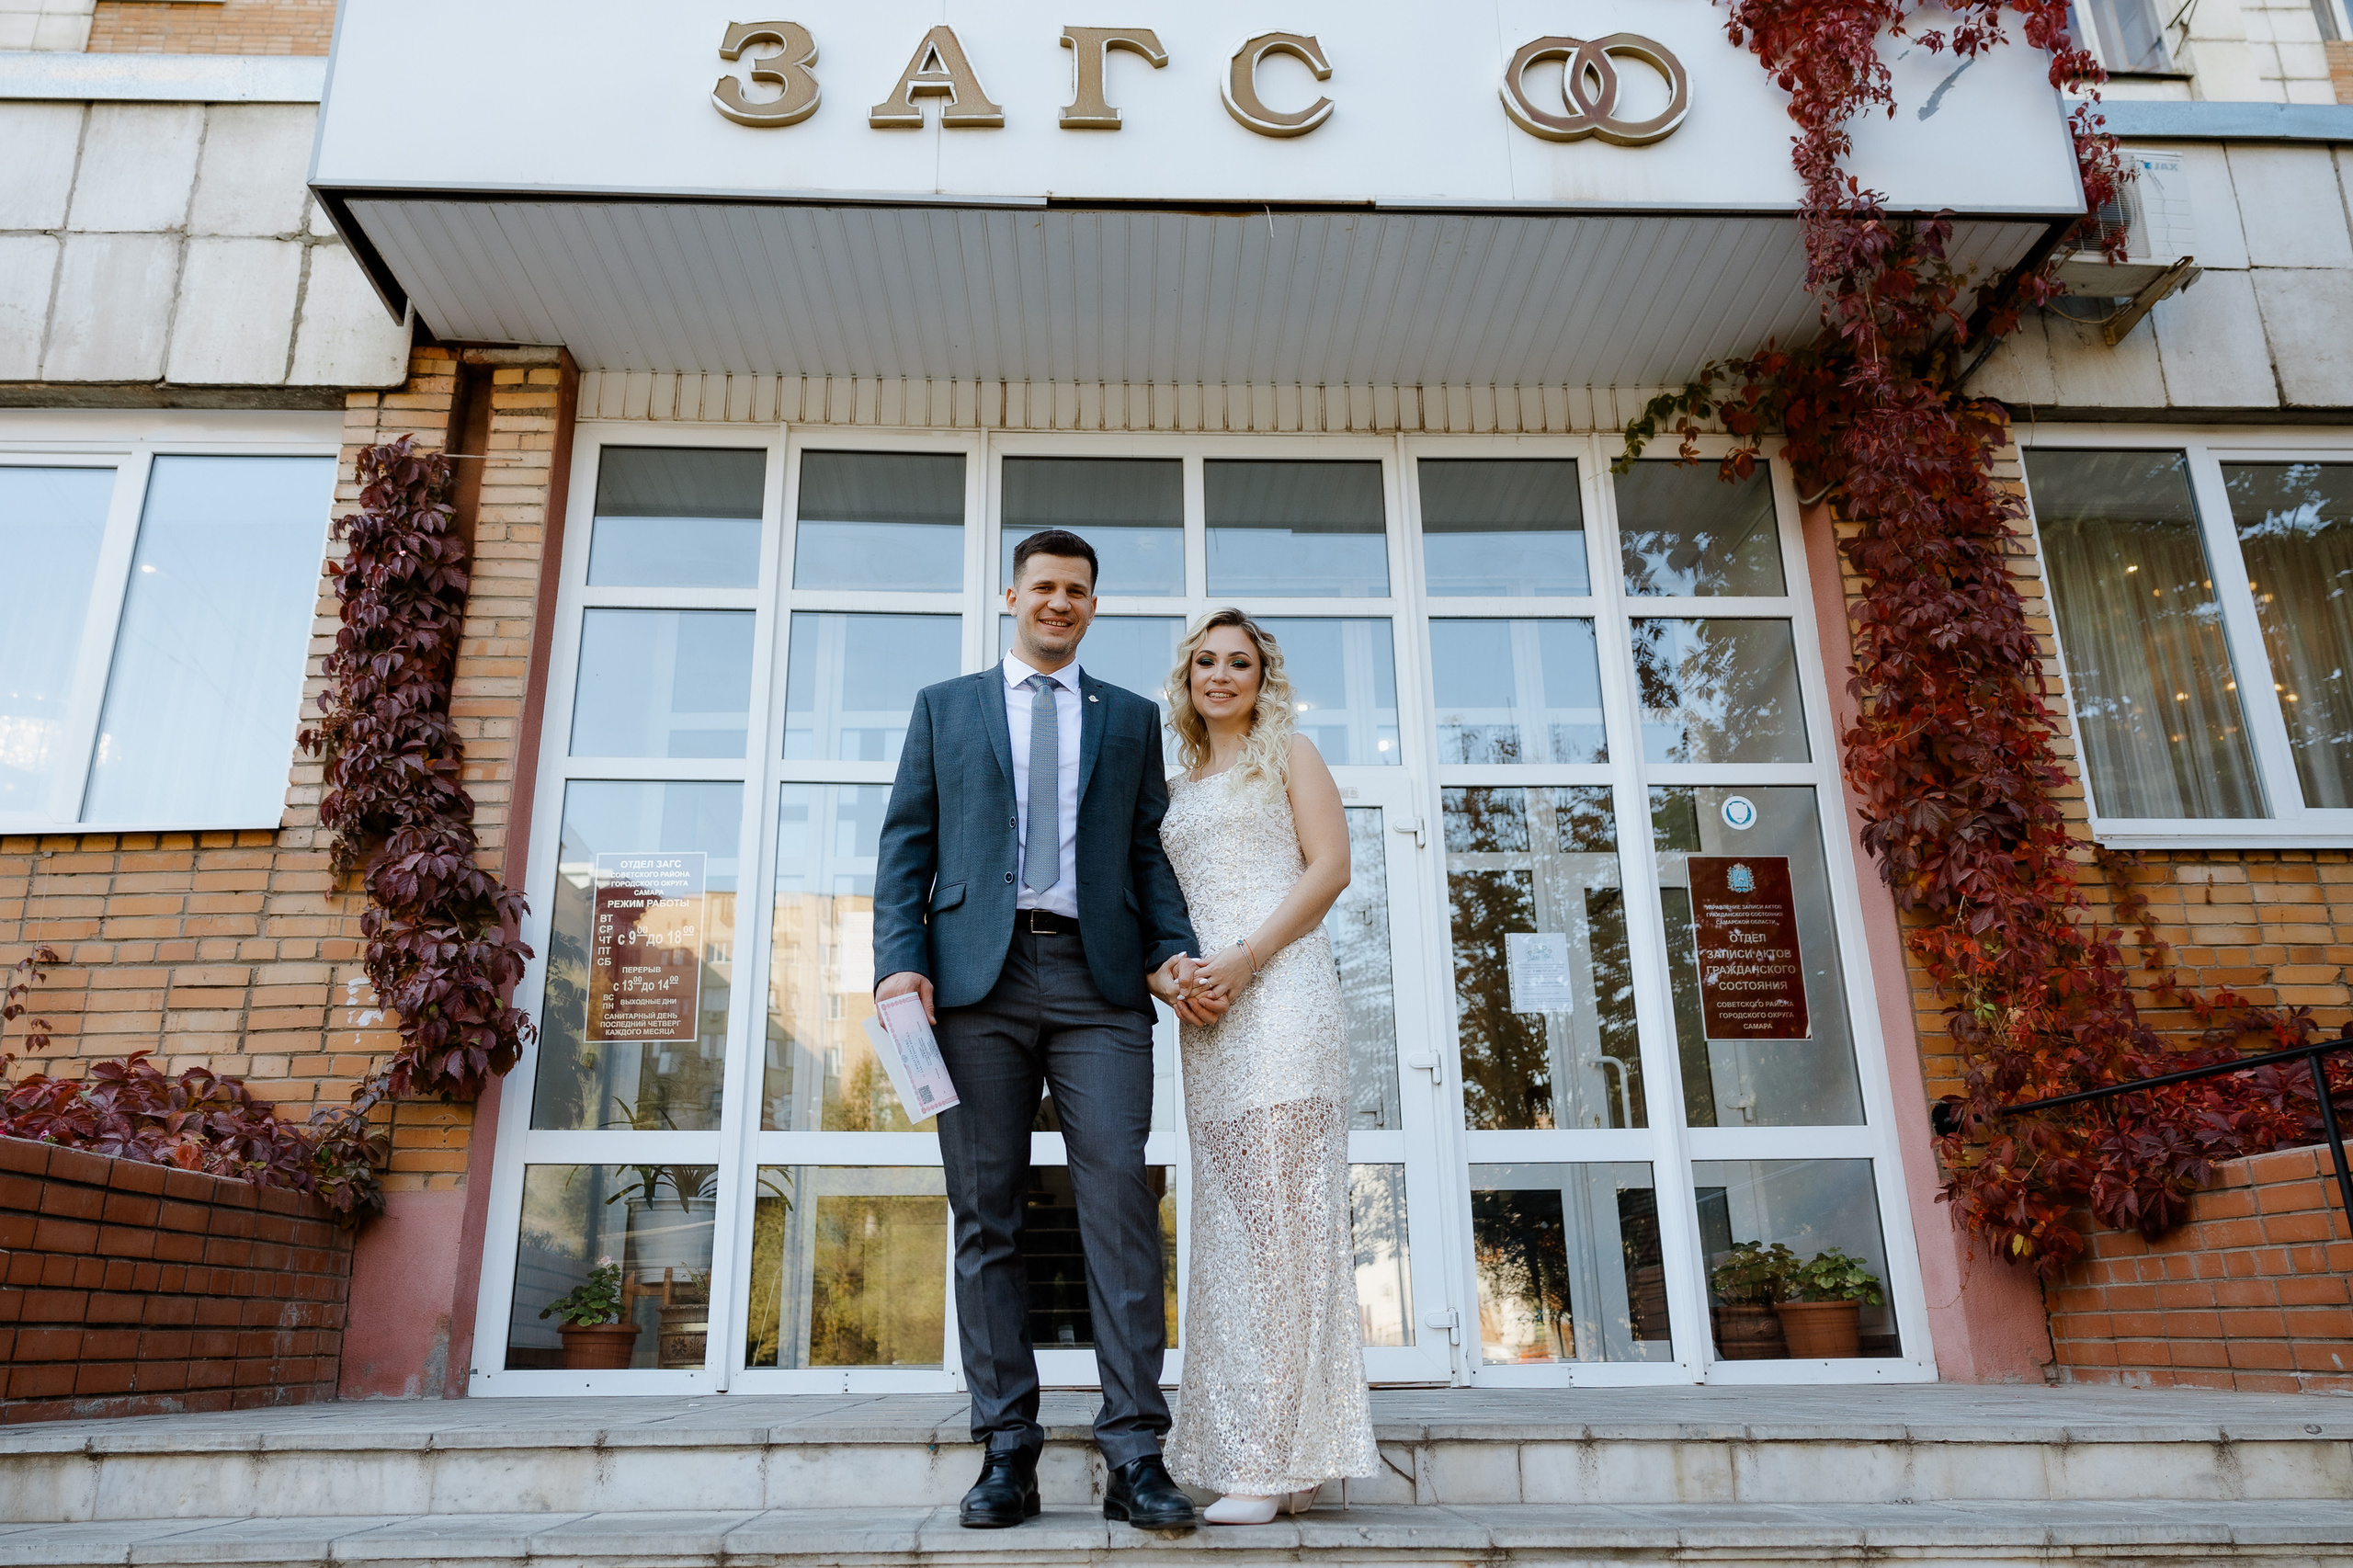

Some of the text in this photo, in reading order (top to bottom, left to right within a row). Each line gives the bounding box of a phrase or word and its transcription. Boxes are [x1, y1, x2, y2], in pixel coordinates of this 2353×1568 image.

[710, 19, 1336, 138] ЗАГС
[620, 860, 654, 869] ОТДЕЛ
[608, 899, 689, 908] РЕЖИМ РАБОТЫ
[600, 915, 613, 923] ВТ
[599, 926, 613, 934] СР
[646, 934, 663, 947] до
[1730, 934, 1766, 943] ОТДЕЛ
[598, 947, 611, 955] ПТ
[1707, 949, 1791, 959] ЗАПИСИ АКТОВ
[597, 958, 611, 966] СБ
[1707, 965, 1796, 975] ГРАЖДАНСКОГО
[642, 983, 654, 992] до
[1719, 981, 1788, 991] СОСТОЯНИЯ
[600, 1019, 646, 1028] ПОСЛЕДНИЙ
